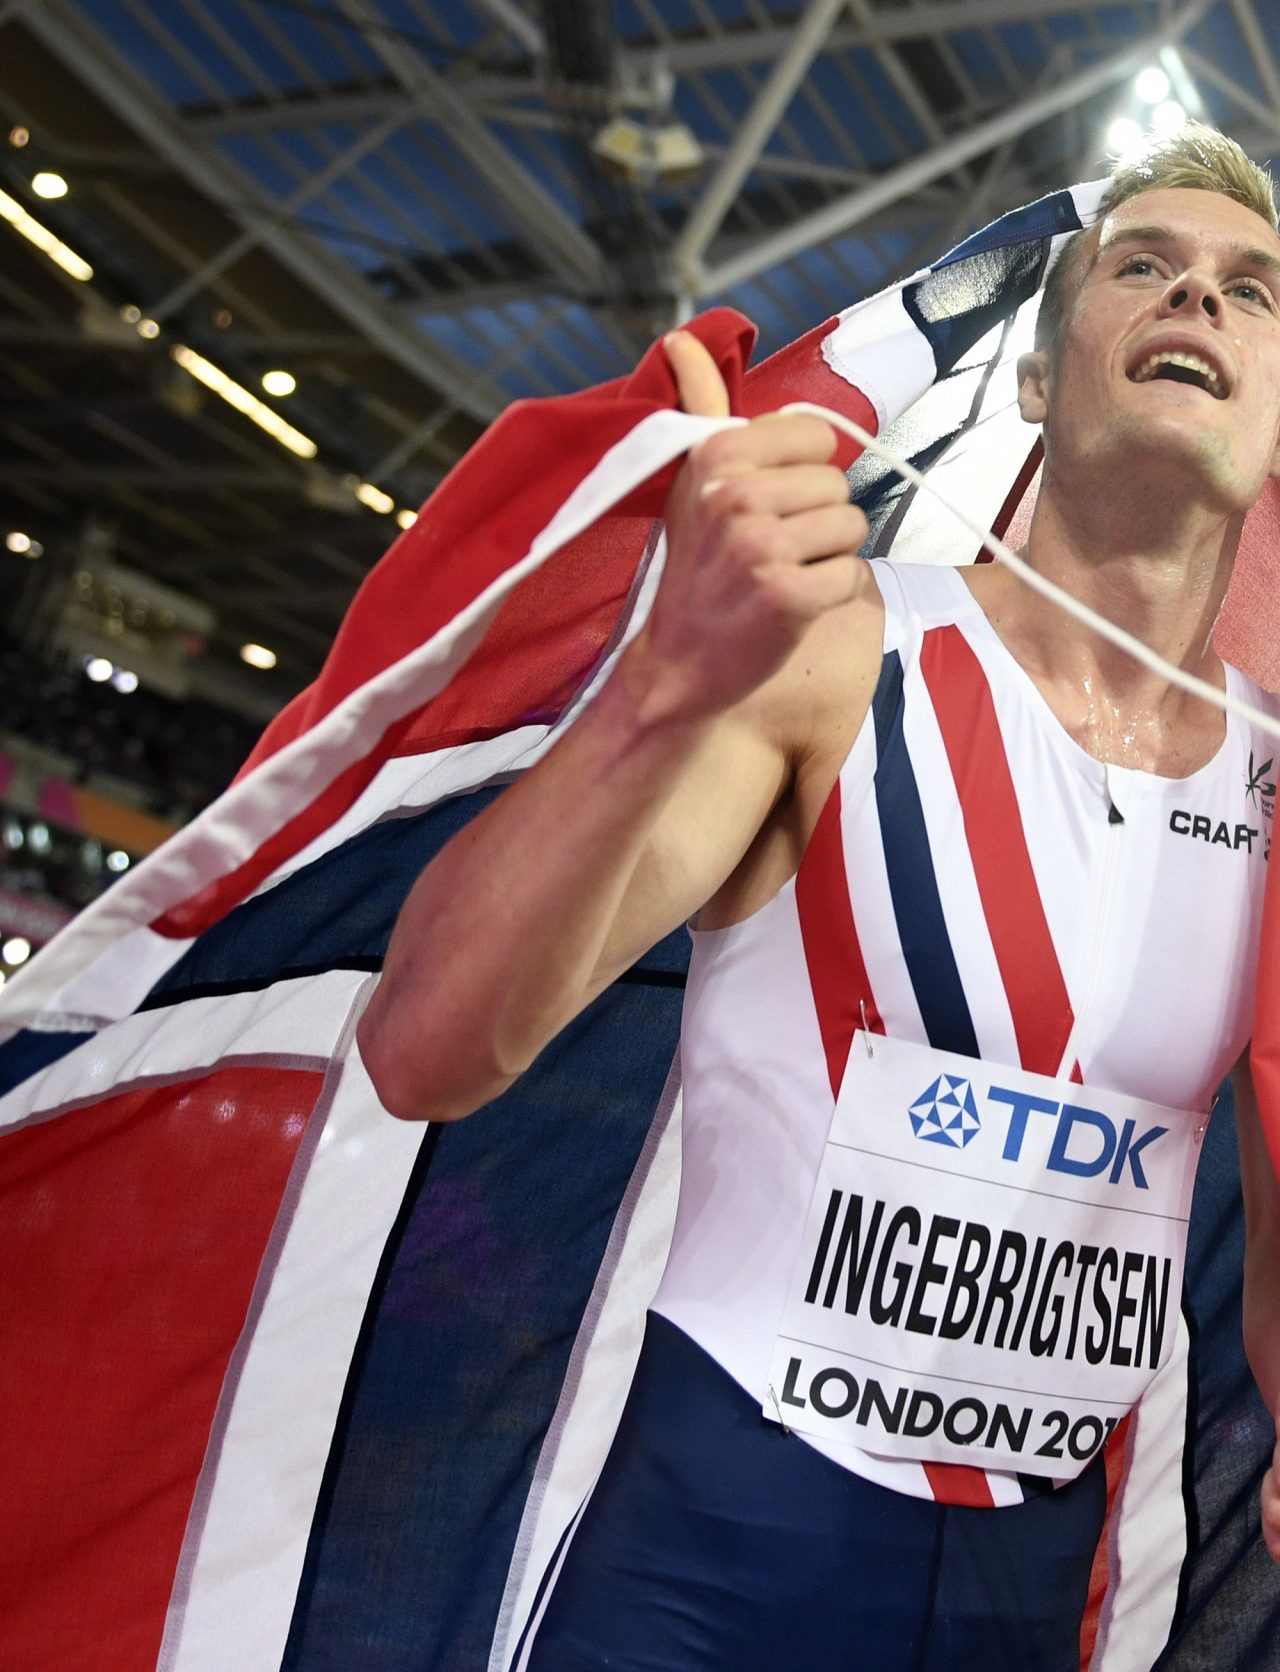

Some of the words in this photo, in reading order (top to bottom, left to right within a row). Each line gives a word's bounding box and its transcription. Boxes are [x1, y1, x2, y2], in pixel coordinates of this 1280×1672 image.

[1169, 809, 1258, 854] CRAFT
[987, 1085, 1169, 1190] TDK
[804, 1189, 1171, 1370] INGEBRIGTSEN
[781, 1356, 1033, 1452] LONDON
[1033, 1410, 1122, 1461] 201
